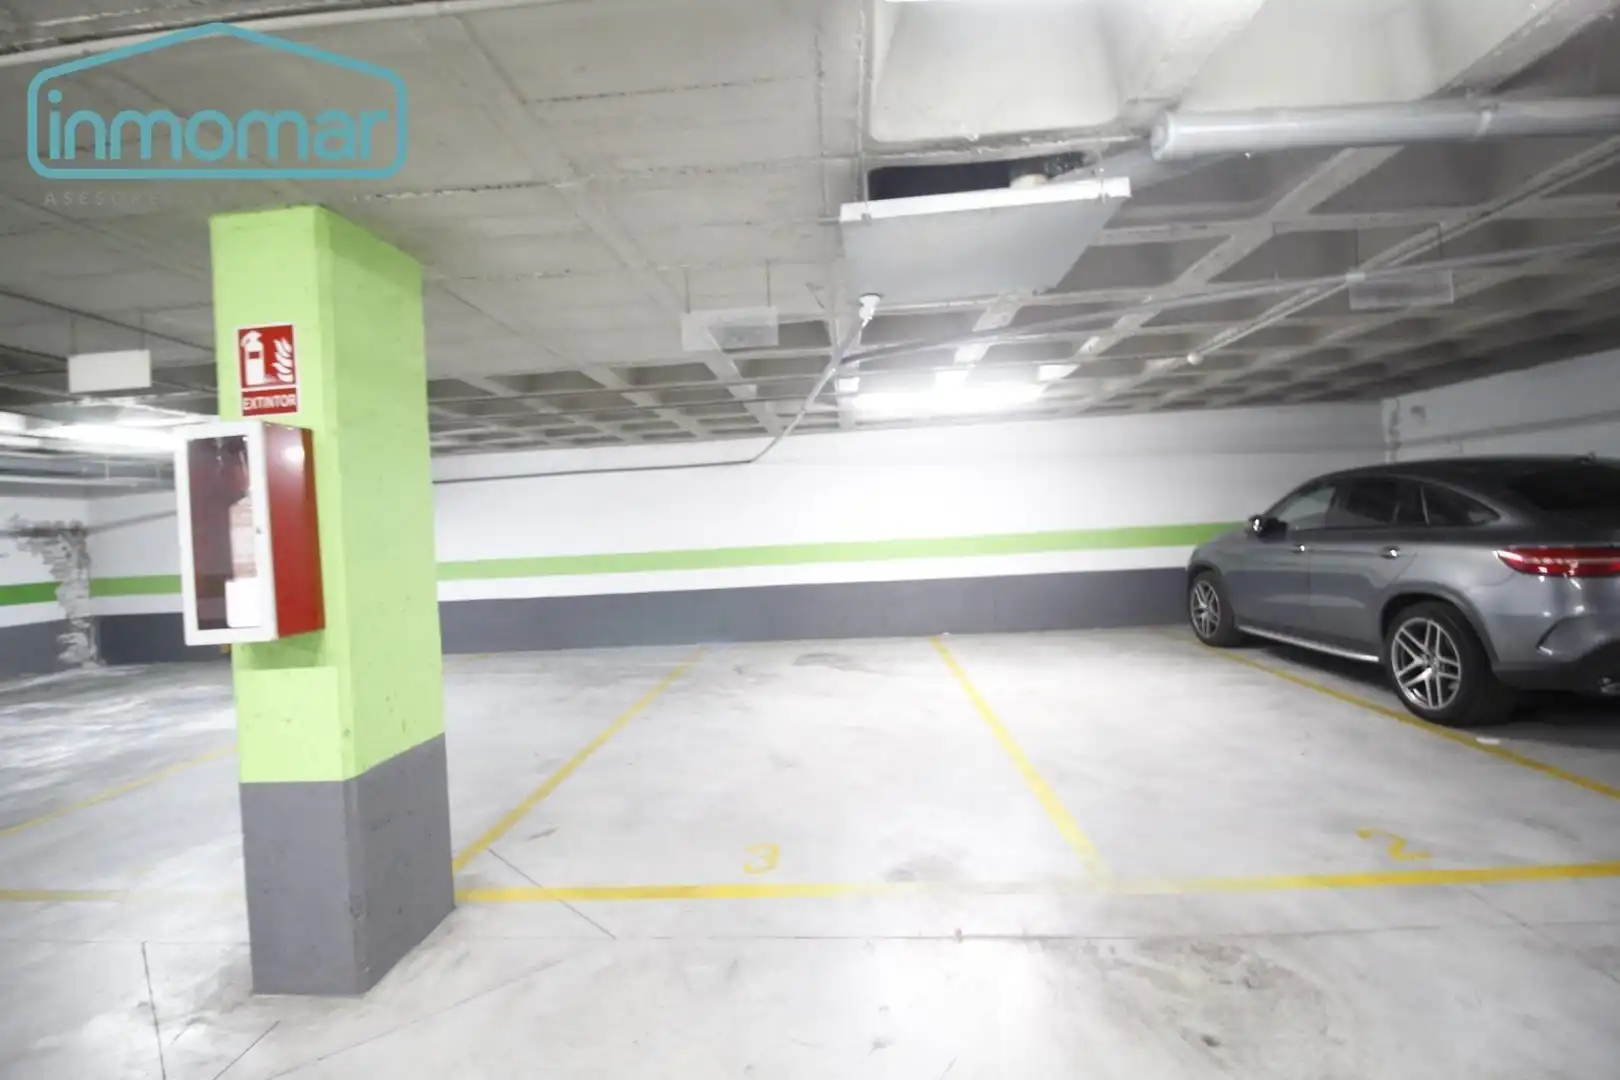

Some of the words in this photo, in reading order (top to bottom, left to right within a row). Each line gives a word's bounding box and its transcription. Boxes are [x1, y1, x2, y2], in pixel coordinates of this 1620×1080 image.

[243, 394, 297, 410] EXTINTOR
[743, 842, 780, 876] 3
[1355, 826, 1433, 862] 2
